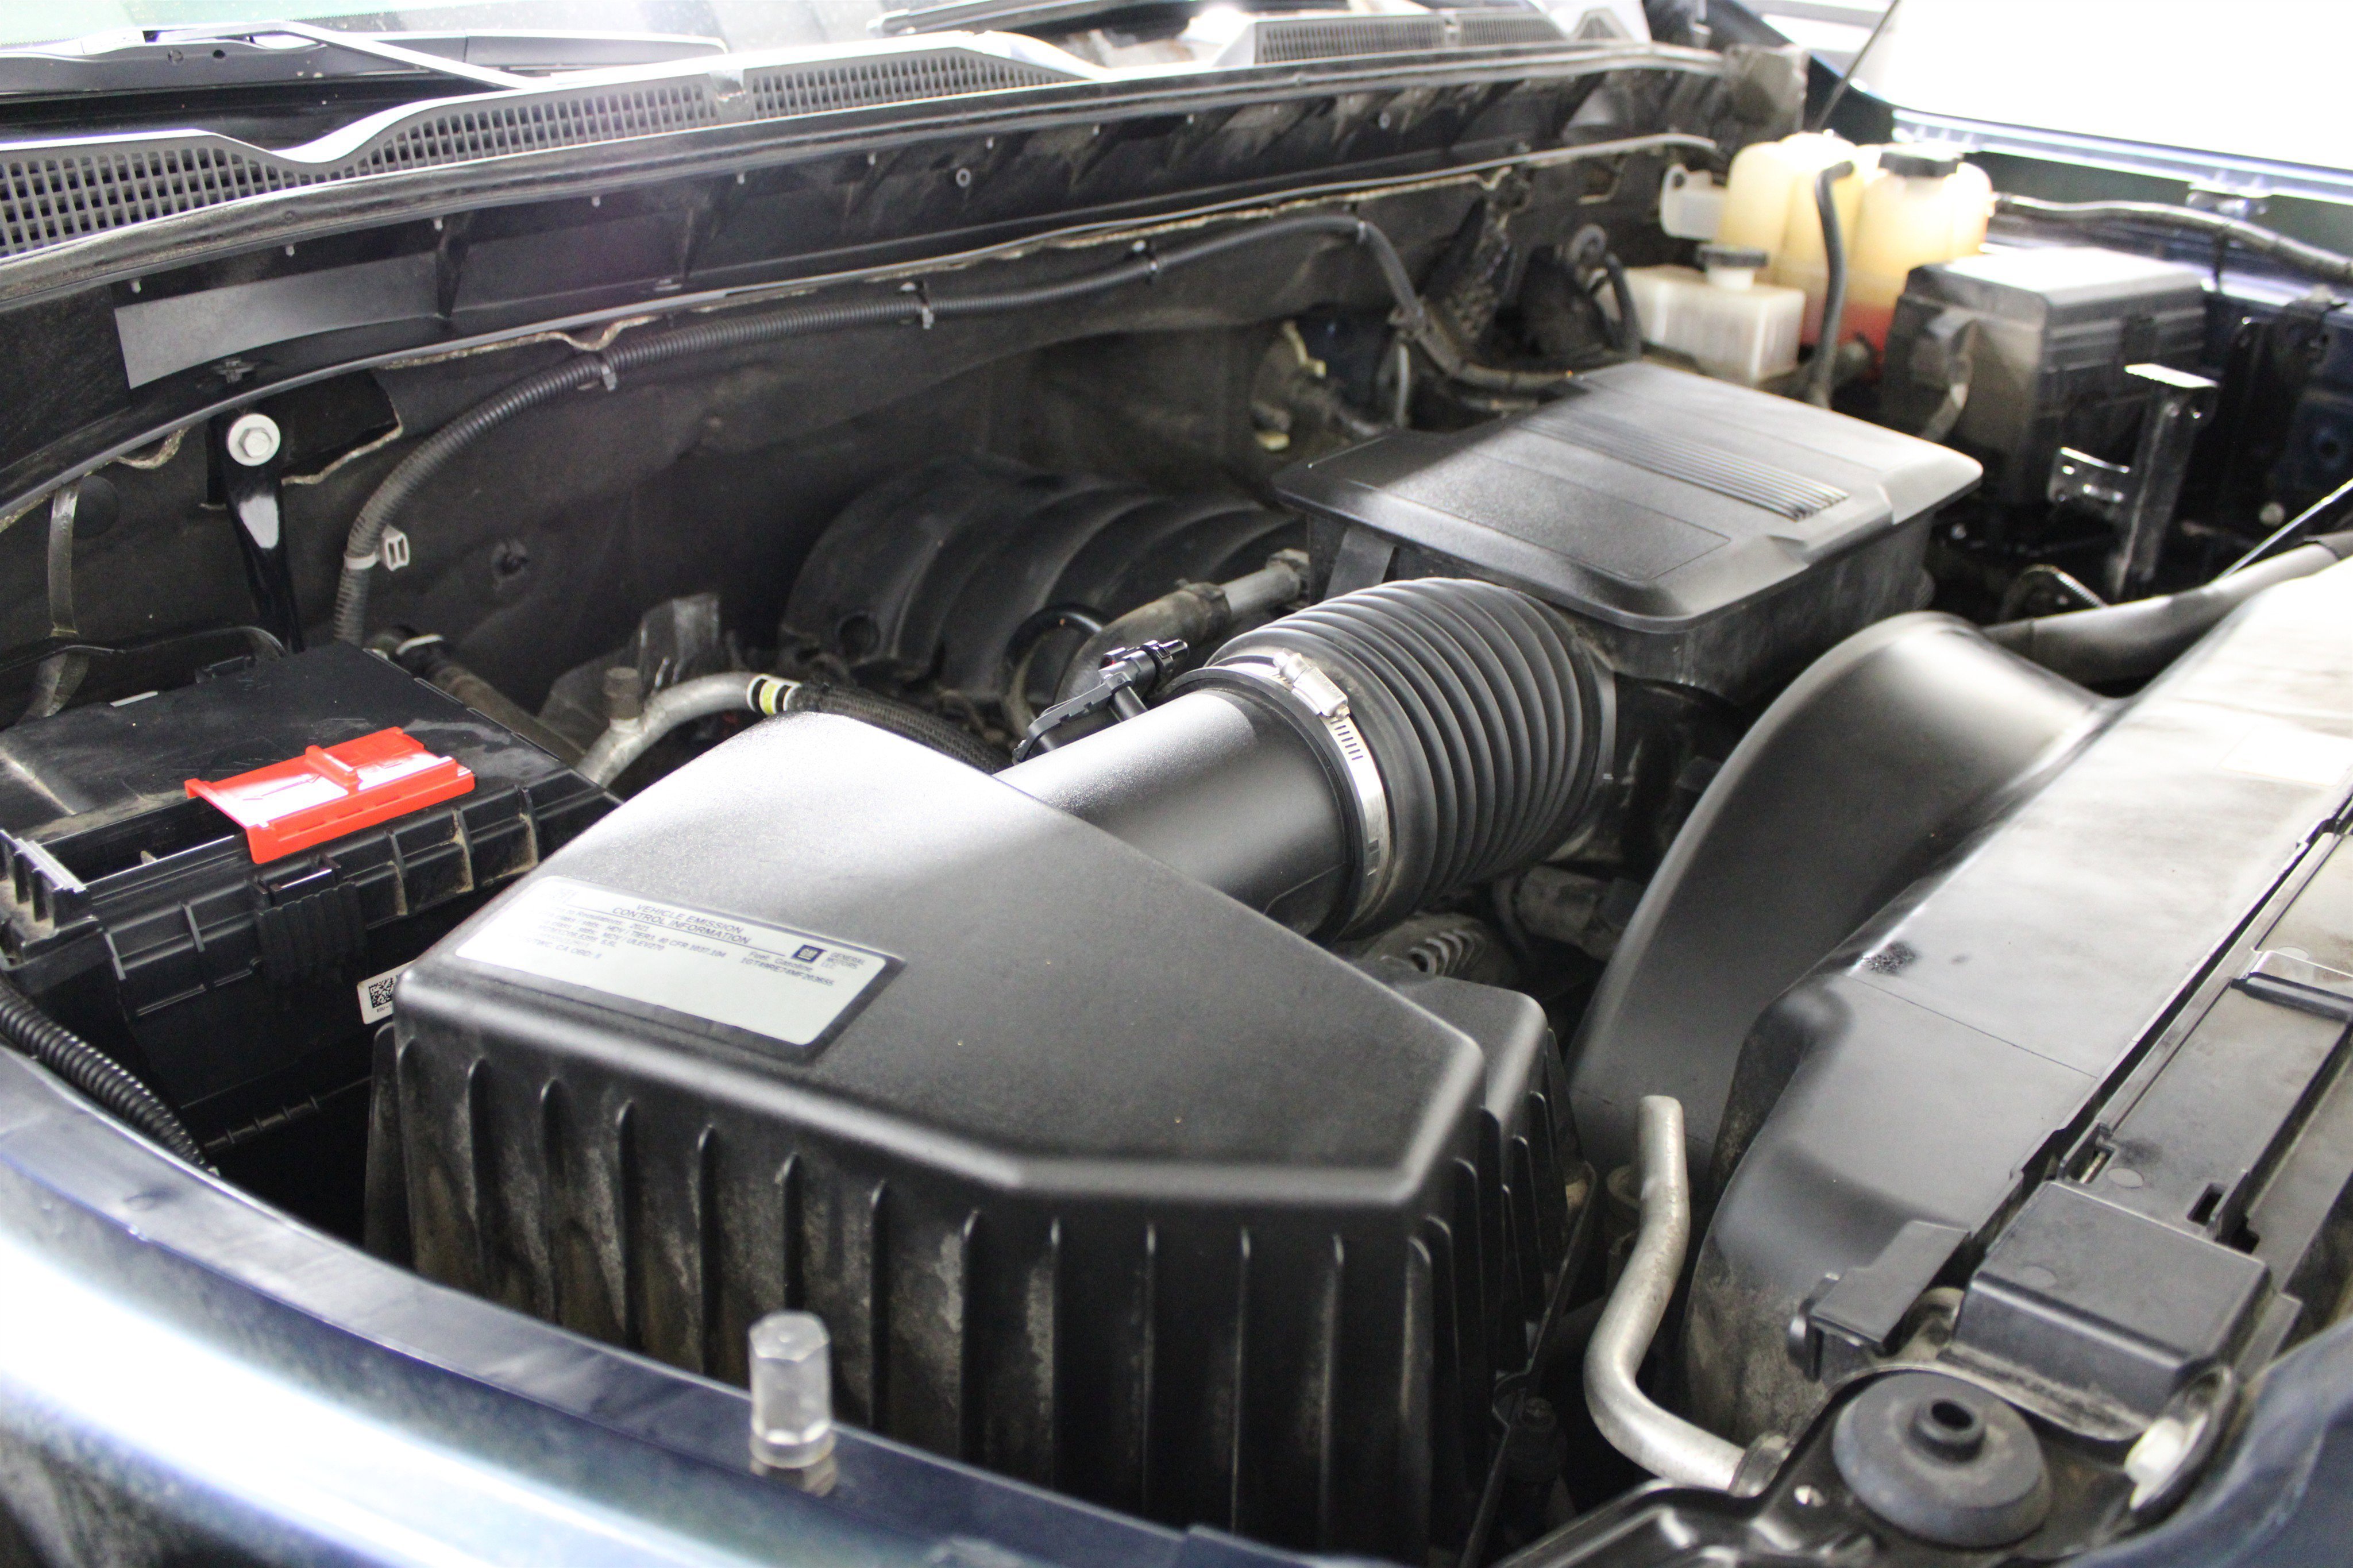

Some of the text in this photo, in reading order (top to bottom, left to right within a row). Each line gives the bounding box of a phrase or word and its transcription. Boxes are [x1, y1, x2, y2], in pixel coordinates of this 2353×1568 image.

[637, 904, 743, 933] VEHICLE EMISSION
[612, 907, 750, 944] CONTROL INFORMATION
[630, 923, 650, 931] 2021
[669, 940, 688, 948] CFR
[774, 958, 813, 971] Gasoline
